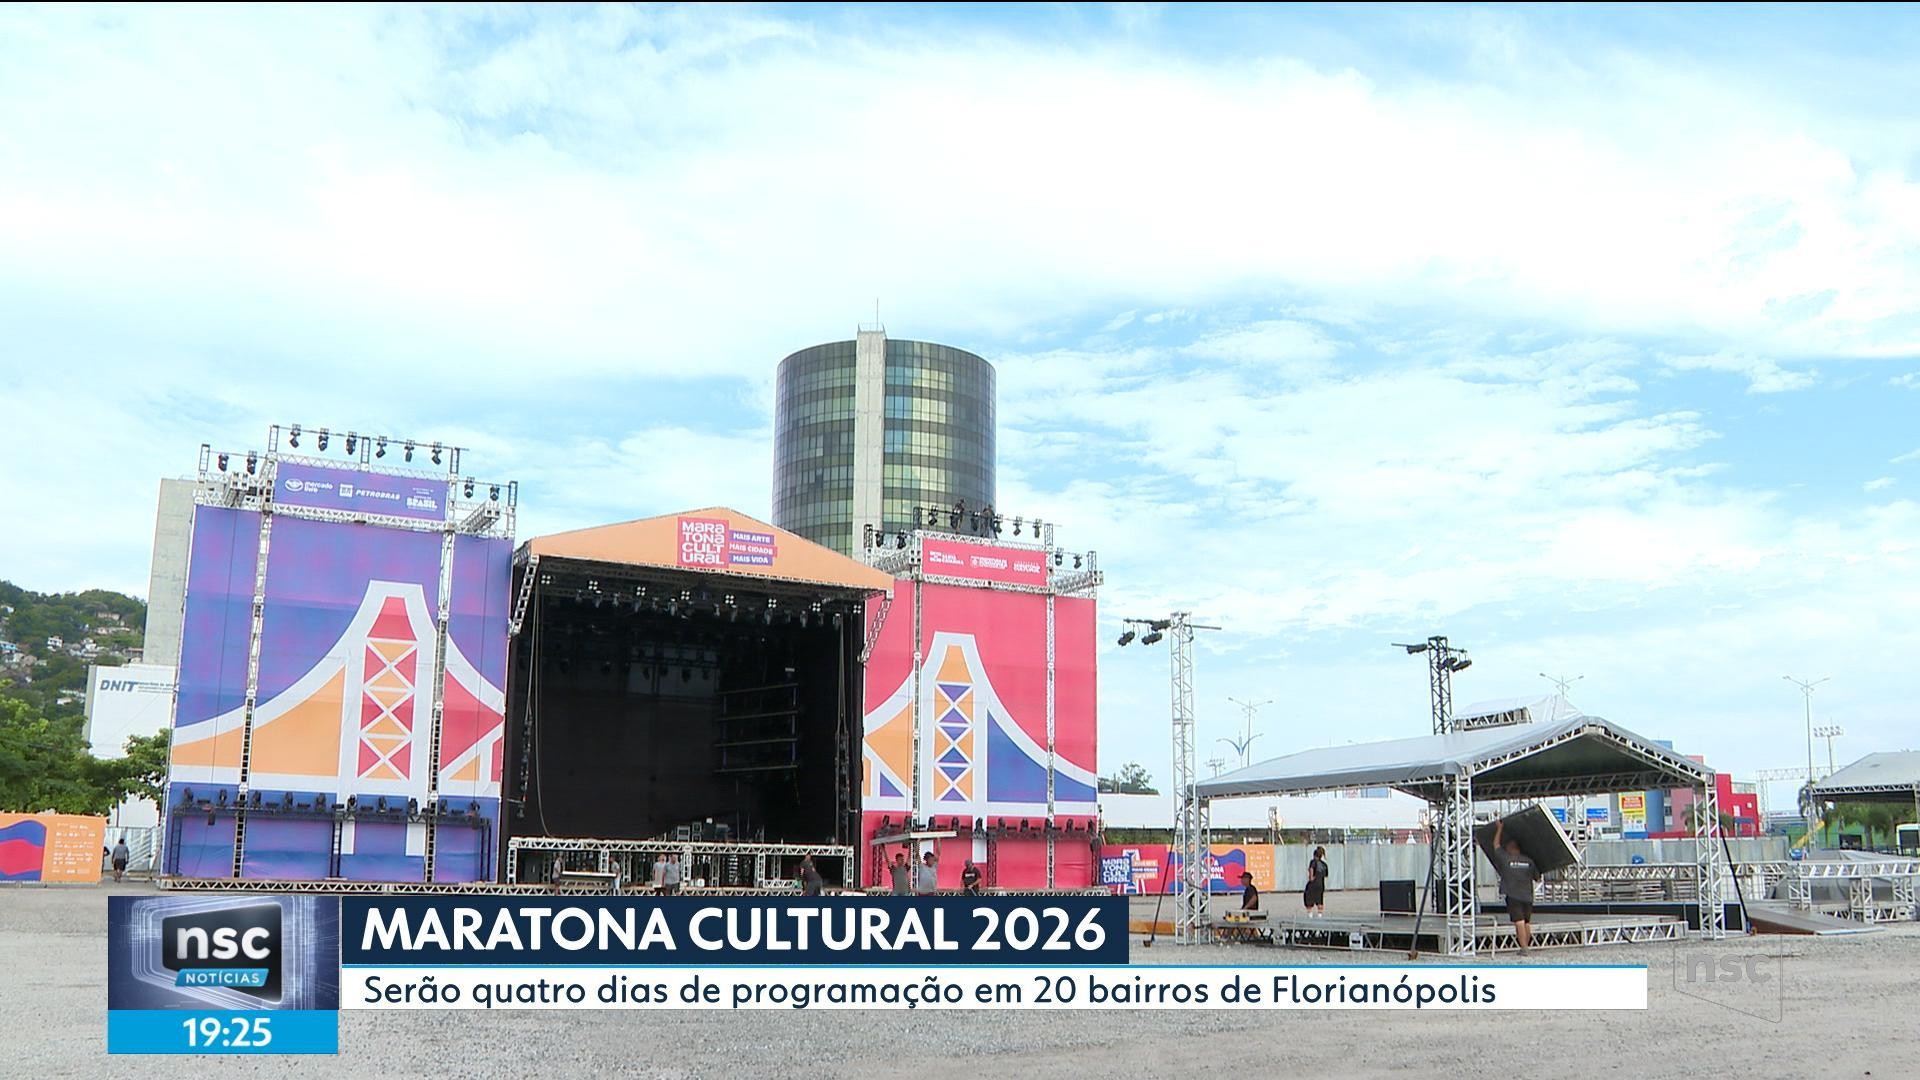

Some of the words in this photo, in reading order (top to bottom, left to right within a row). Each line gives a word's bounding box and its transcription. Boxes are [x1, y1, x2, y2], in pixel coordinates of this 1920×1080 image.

[355, 489, 401, 500] PETROBRAS
[733, 533, 750, 541] MAIS
[751, 535, 771, 543] ARTE
[681, 542, 725, 554] CULT
[729, 543, 746, 552] MAIS
[747, 545, 773, 555] CIDADE
[733, 555, 750, 563] MAIS
[751, 556, 768, 564] VIDA
[100, 680, 138, 692] DNIT
